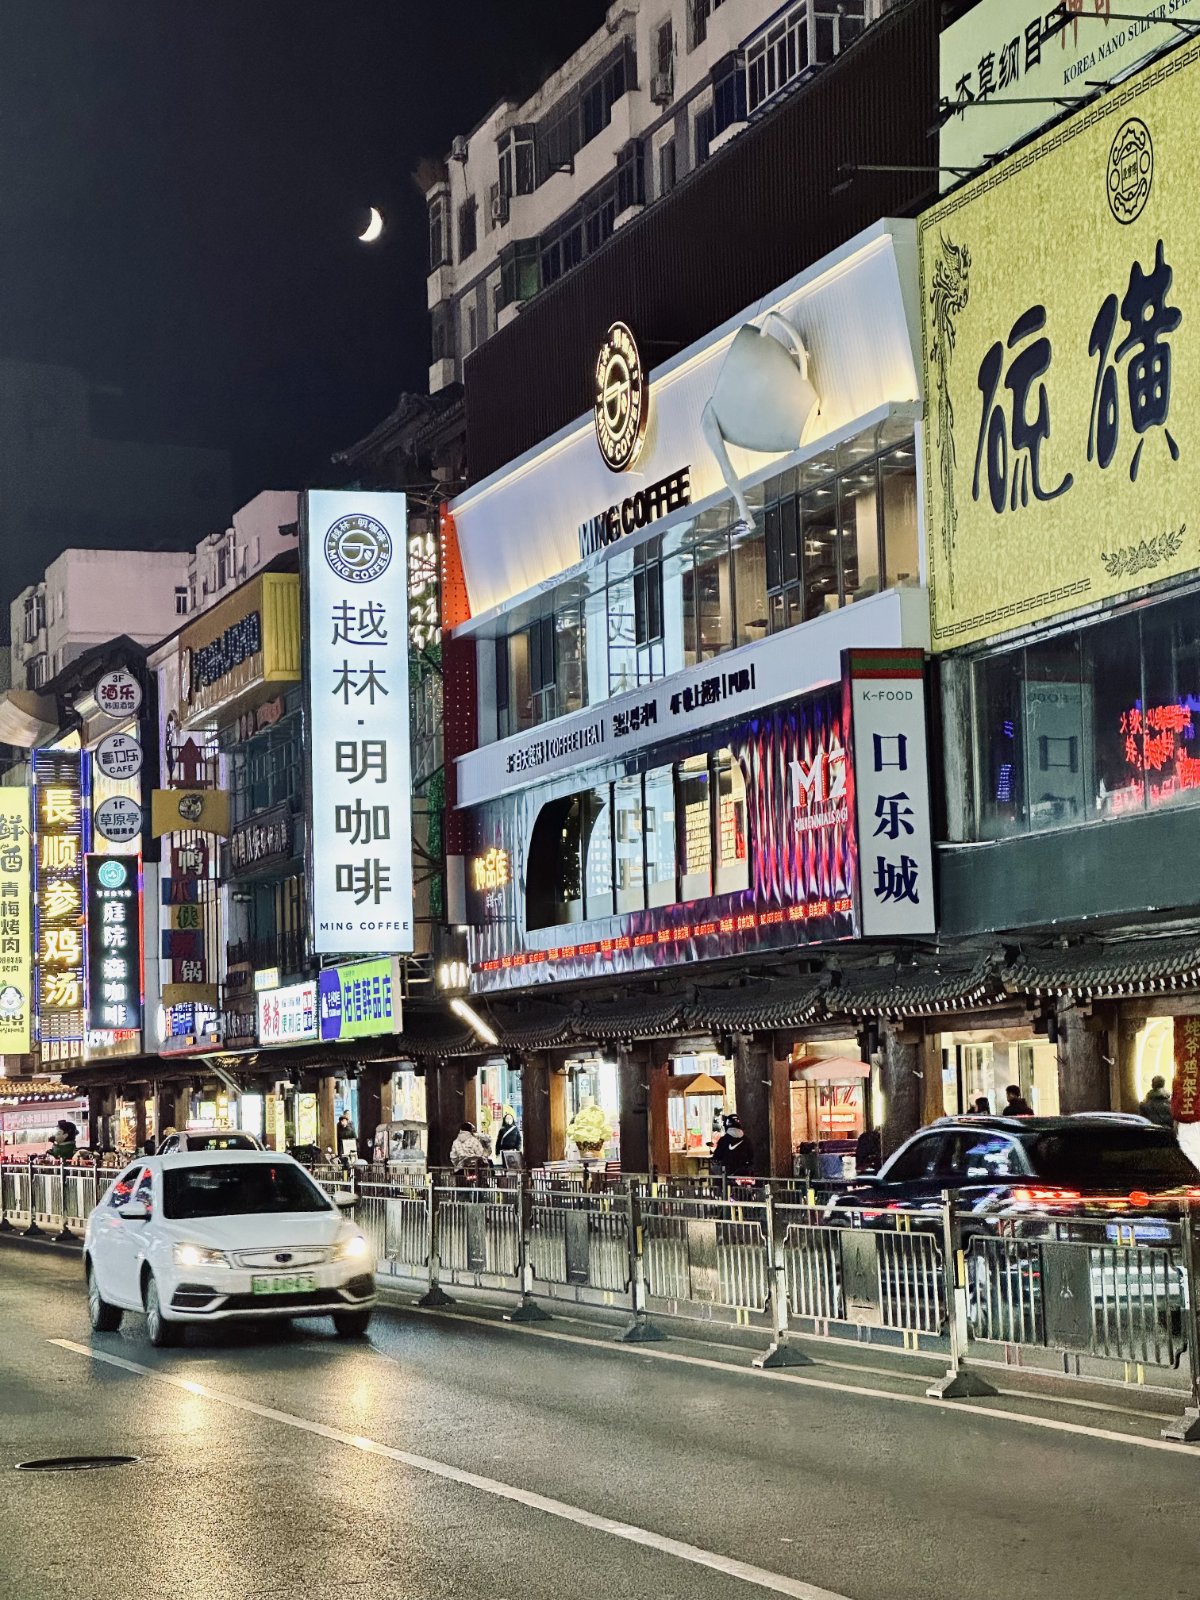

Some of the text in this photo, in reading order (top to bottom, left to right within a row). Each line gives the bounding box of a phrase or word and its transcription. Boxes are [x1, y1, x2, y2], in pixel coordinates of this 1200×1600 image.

[1063, 50, 1096, 86] KOREA
[1098, 31, 1126, 62] NANO
[1127, 4, 1167, 42] SULFUR
[955, 16, 1042, 121] 本草纲目
[597, 390, 640, 462] MING COFFEE
[579, 465, 692, 560] MING COFFEE
[327, 549, 389, 580] MING COFFEE
[112, 674, 125, 683] 3F
[102, 683, 135, 700] 酒乐
[113, 738, 125, 748] 2F
[109, 765, 134, 774] CAFE
[113, 801, 126, 810] 1F
[100, 811, 139, 827] 草原亭
[872, 733, 920, 905] 口乐城
[1, 881, 22, 954] 青梅烤肉
[320, 921, 409, 931] MING COFFEE
